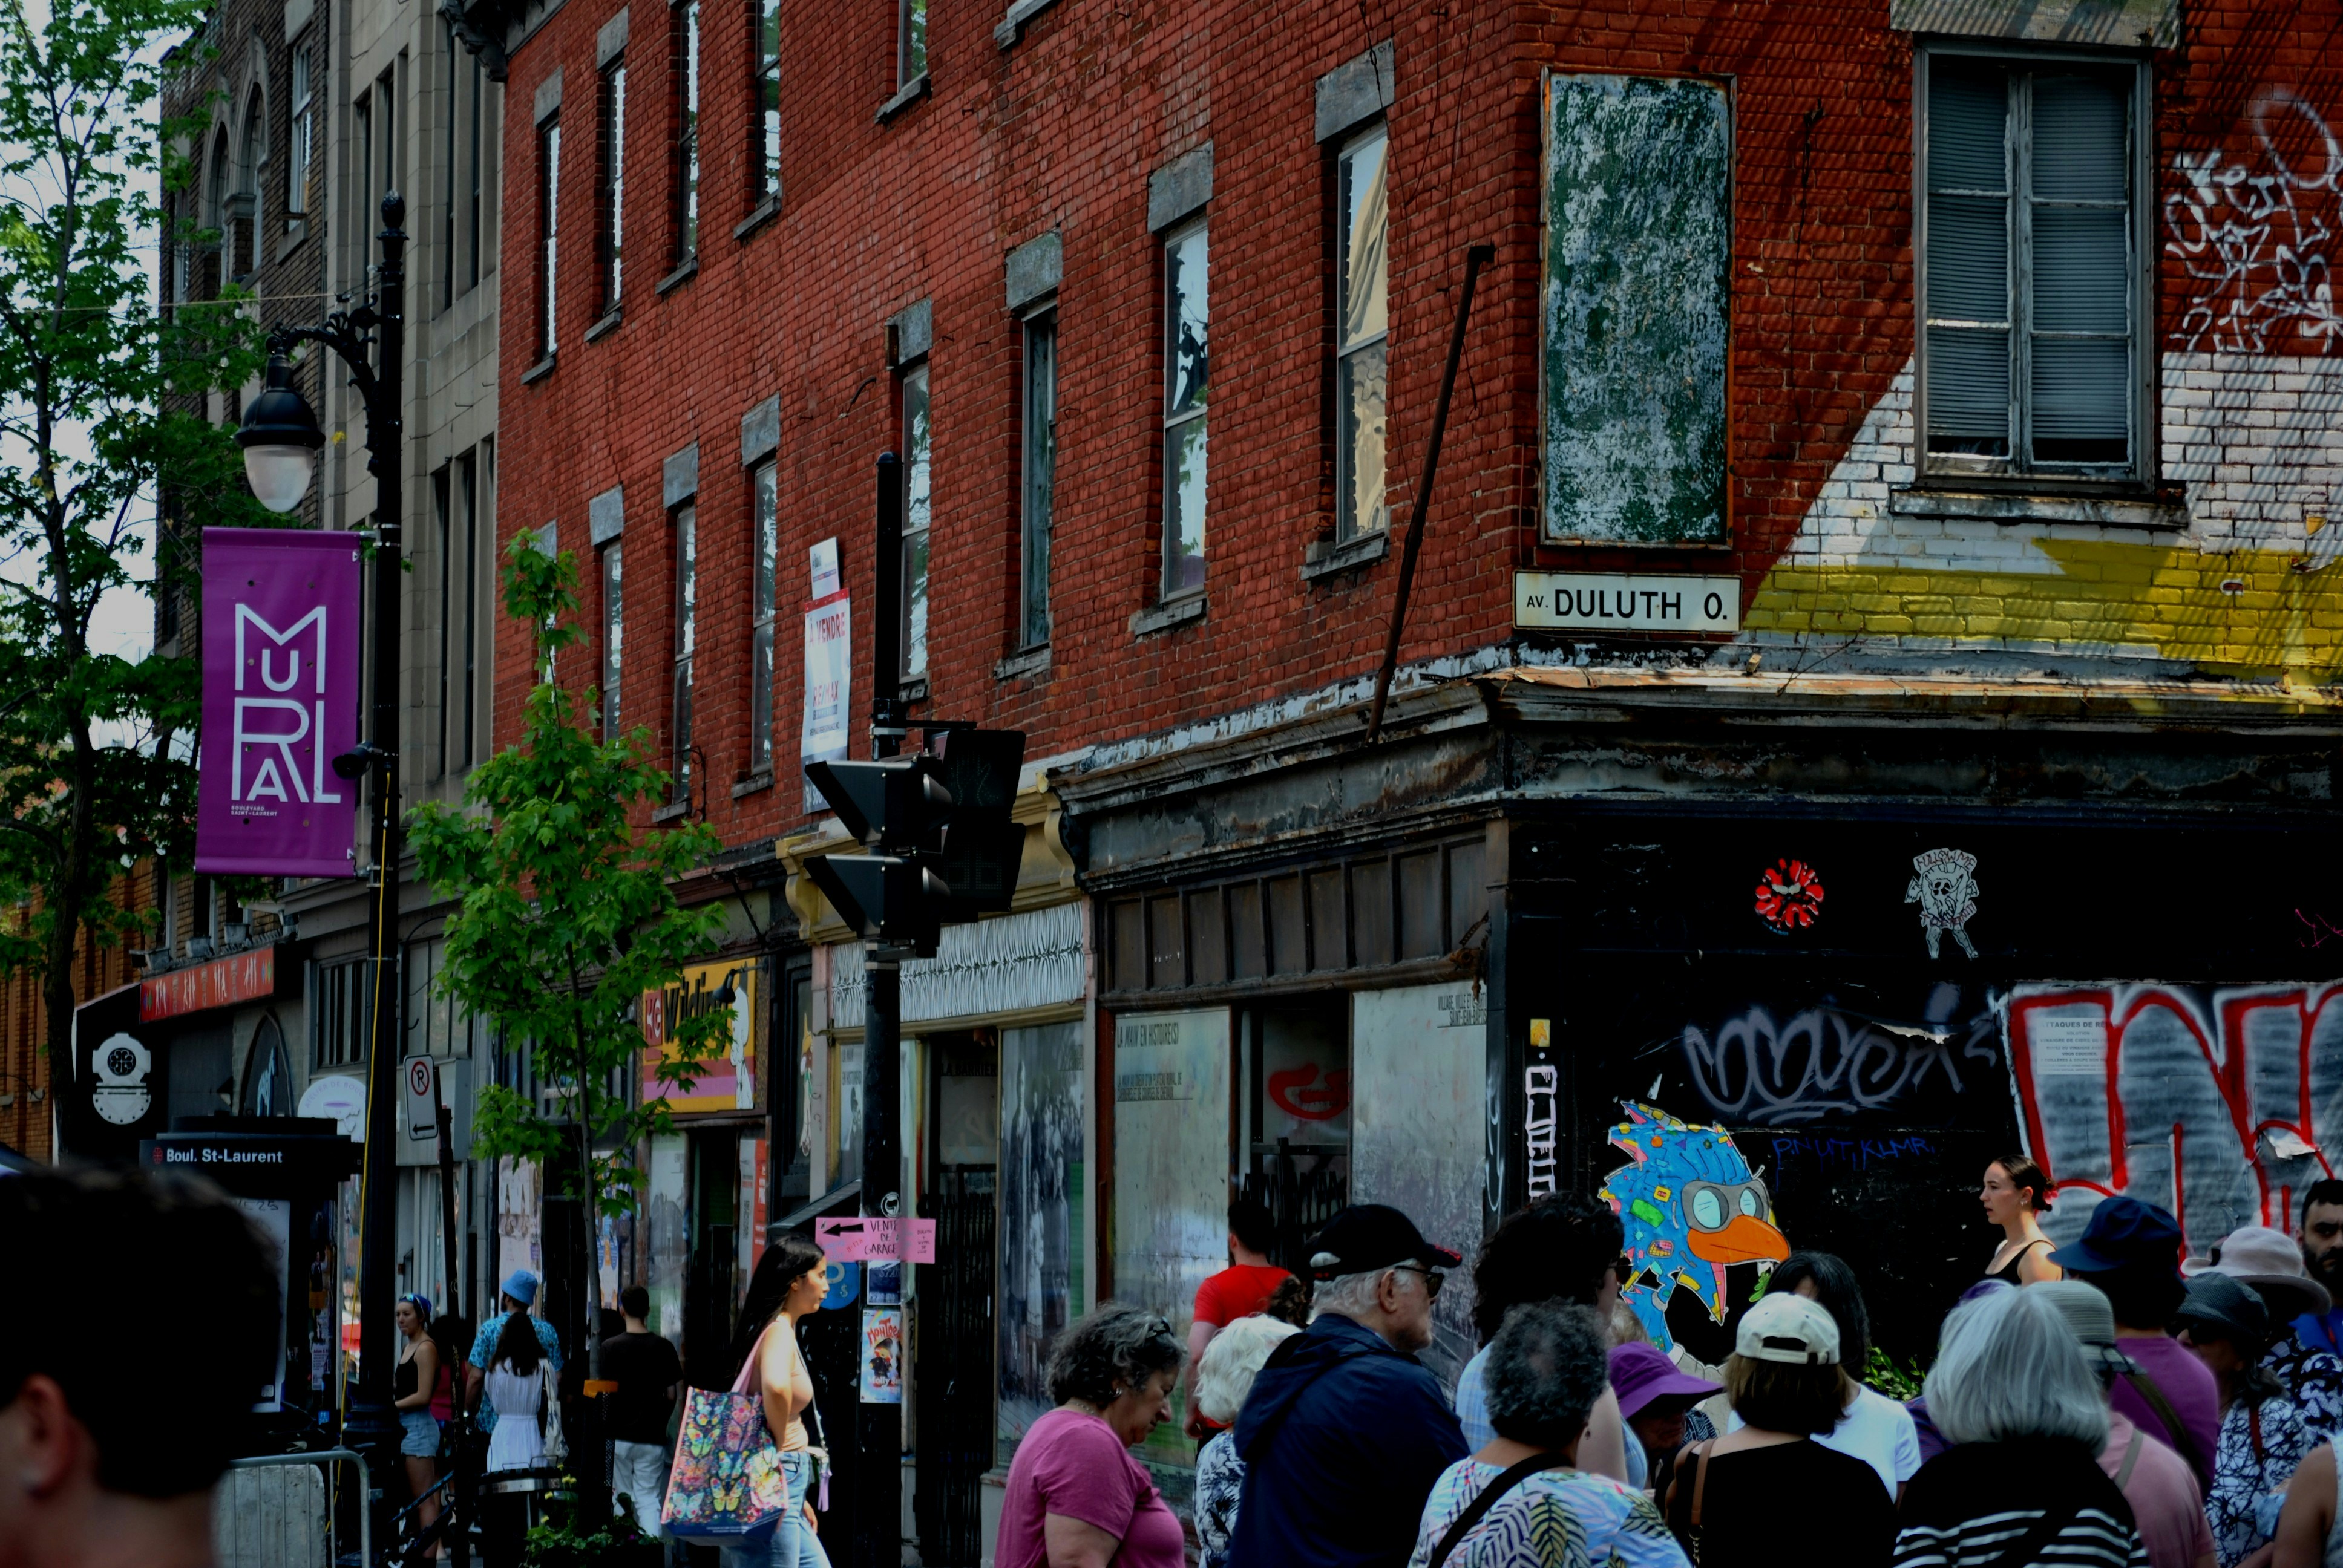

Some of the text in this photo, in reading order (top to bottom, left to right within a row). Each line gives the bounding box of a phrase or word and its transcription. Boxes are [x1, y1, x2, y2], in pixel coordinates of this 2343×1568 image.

[1527, 589, 1727, 620] AV. DULUTH O.
[816, 612, 845, 644] VENDRE
[1140, 1025, 1147, 1047] EN
[166, 1146, 283, 1163] Boul. St-Laurent
[870, 1220, 897, 1232] VENTE
[880, 1233, 890, 1242] DE
[864, 1243, 897, 1255] GARAGE
